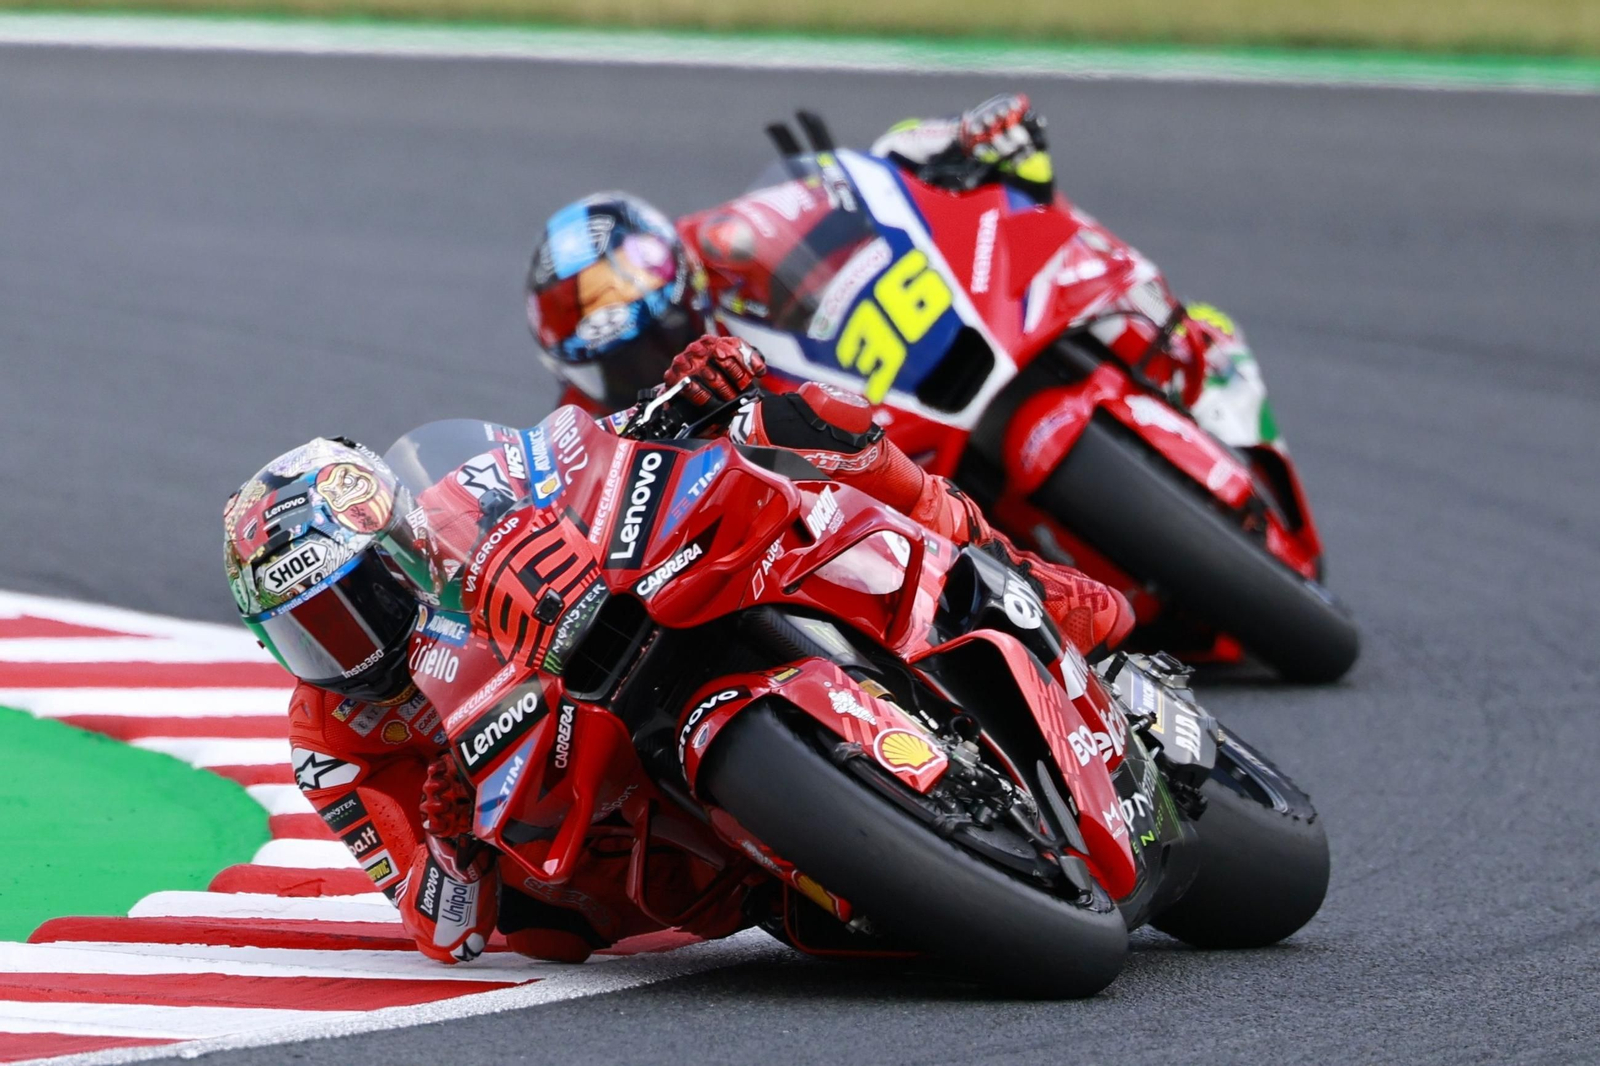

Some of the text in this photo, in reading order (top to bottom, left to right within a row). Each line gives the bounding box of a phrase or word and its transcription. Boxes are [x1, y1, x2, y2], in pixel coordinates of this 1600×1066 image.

[835, 248, 953, 405] 36
[504, 443, 526, 479] WRS
[687, 461, 724, 498] TIM
[265, 497, 306, 519] Lenovo
[588, 443, 629, 544] FRECCIAROSSA
[610, 452, 662, 561] Lenovo
[806, 484, 838, 540] DUCATI
[269, 547, 320, 588] SHOEI
[465, 516, 520, 593] VARGROUP
[636, 543, 703, 596] CARRERA
[552, 583, 606, 653] MONSTER
[446, 665, 516, 728] FRECCIAROSSA
[460, 692, 538, 767] Lenovo
[555, 705, 575, 768] CARRERA
[500, 756, 525, 798] TIM
[418, 866, 440, 915] Lenovo
[442, 880, 474, 923] Unipol
